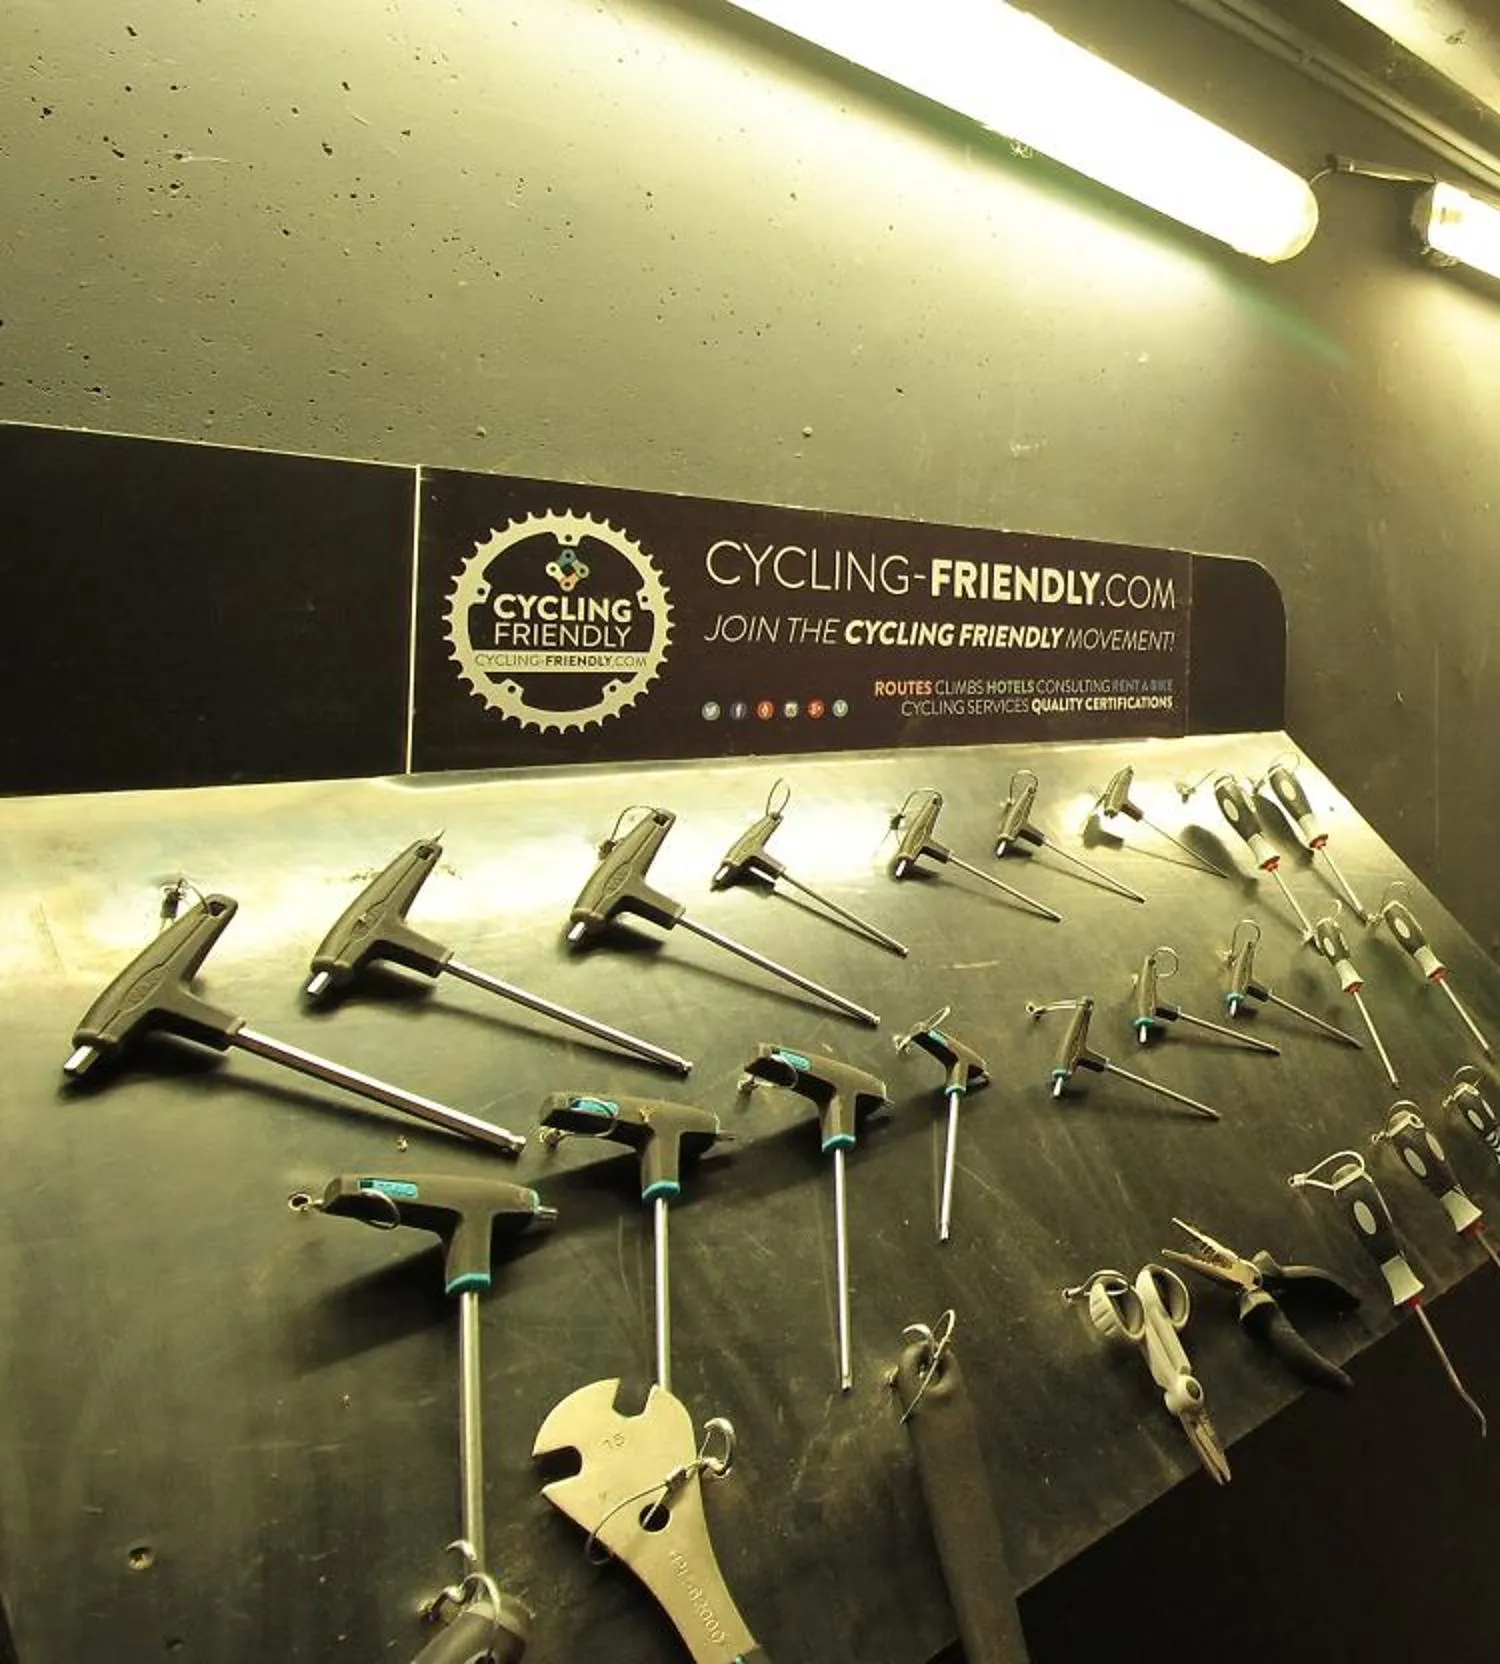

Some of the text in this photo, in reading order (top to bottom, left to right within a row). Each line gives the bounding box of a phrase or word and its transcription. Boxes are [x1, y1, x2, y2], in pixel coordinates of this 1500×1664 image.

[706, 540, 1175, 610] CYCLING-FRIENDLY.COM
[493, 593, 632, 622] CYCLING
[494, 622, 631, 647] FRIENDLY
[704, 614, 1175, 652] JOIN THE CYCLING FRIENDLY MOVEMENT!
[475, 653, 647, 668] CYCLING-FRIENDLY.COM
[875, 681, 932, 696] ROUTES
[935, 680, 984, 695] CLIMBS
[987, 680, 1034, 694] HOTELS
[1036, 679, 1110, 694] CONSULTING
[901, 695, 1173, 716] CYCLING SERVICES QUALITY CERTIFICATIONS
